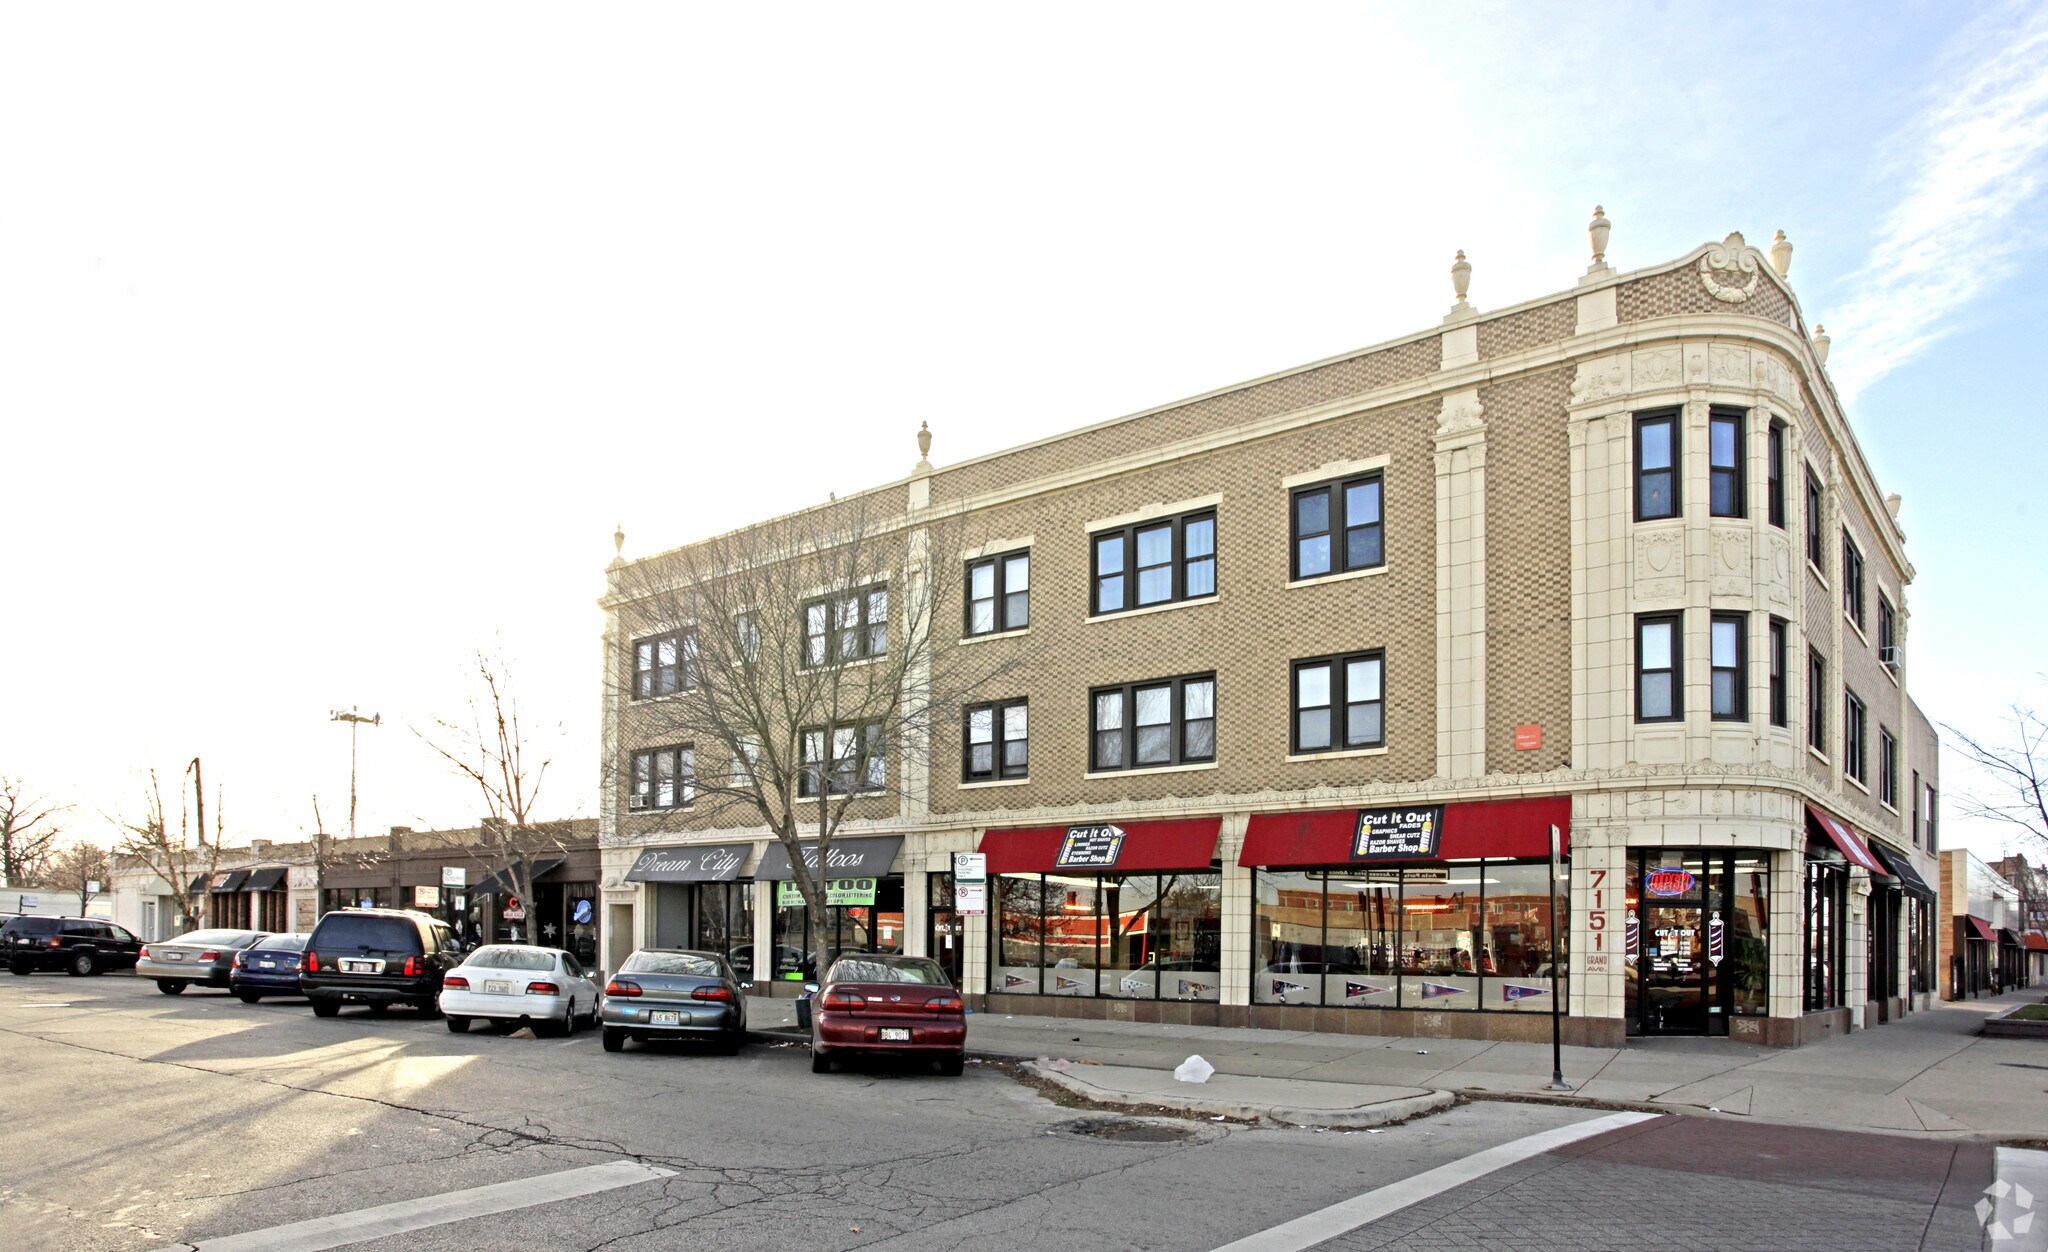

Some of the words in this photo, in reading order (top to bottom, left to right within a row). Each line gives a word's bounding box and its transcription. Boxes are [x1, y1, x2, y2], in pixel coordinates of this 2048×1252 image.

[1364, 814, 1387, 824] Cut
[1406, 812, 1432, 822] Out
[1070, 830, 1088, 838] Cut
[1369, 845, 1396, 853] Barber
[1398, 844, 1418, 853] Shop
[634, 852, 691, 871] Dream
[701, 848, 740, 880] City
[1090, 855, 1105, 863] Shop
[782, 879, 873, 892] TTOO
[1650, 873, 1691, 892] OPEN
[1589, 870, 1606, 951] 7151
[1655, 929, 1668, 937] CUT
[1680, 929, 1696, 937] OUT
[1587, 955, 1607, 964] GRAND
